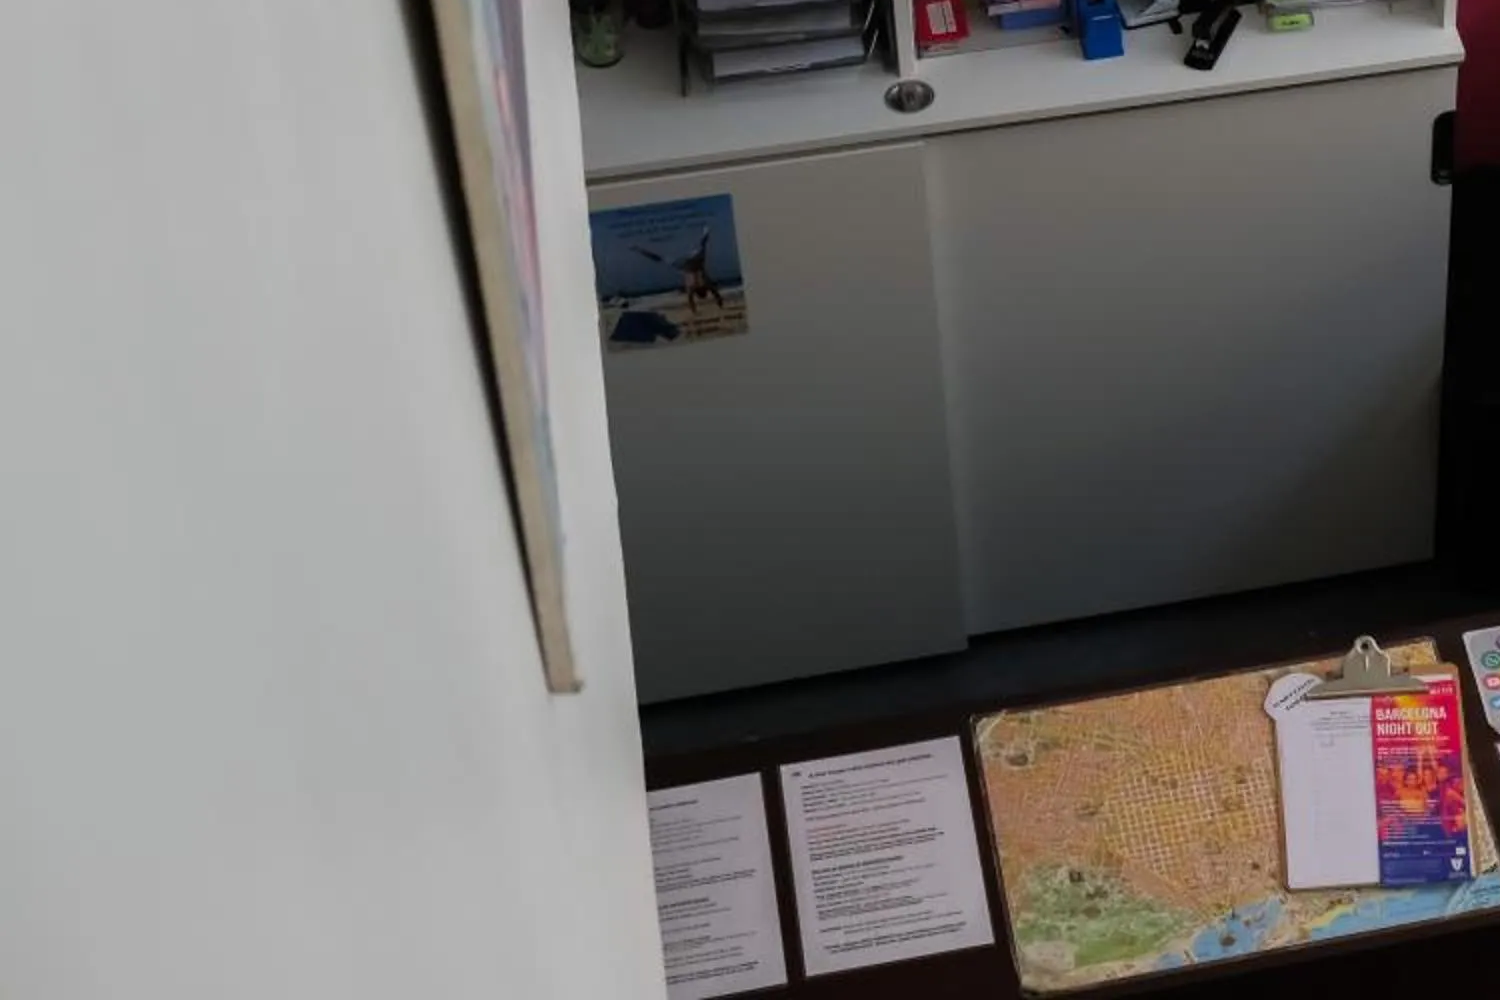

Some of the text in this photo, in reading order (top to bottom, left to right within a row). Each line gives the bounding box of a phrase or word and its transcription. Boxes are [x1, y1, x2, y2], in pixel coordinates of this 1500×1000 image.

[1376, 707, 1447, 722] BARCELONA
[1377, 722, 1412, 737] NIGHT
[1415, 721, 1438, 736] OUT
